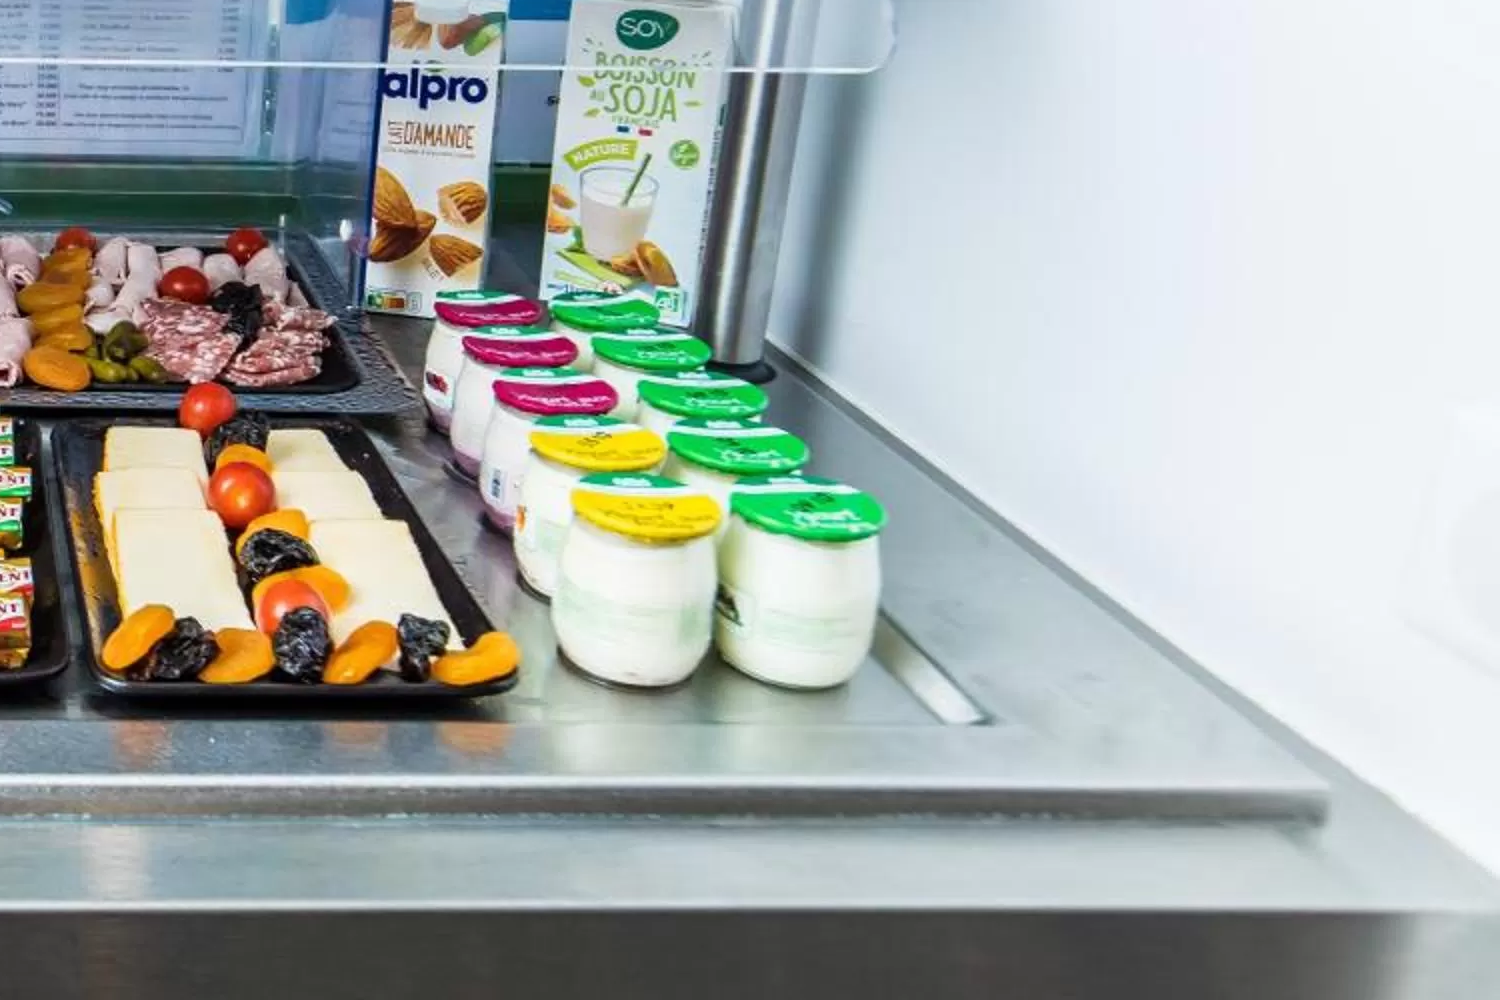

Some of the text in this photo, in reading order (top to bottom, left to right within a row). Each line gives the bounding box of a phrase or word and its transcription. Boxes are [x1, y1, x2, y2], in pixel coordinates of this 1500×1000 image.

[619, 17, 672, 39] SOY
[383, 59, 489, 111] alpro
[593, 51, 696, 89] BOISSON
[604, 83, 676, 122] SOJA
